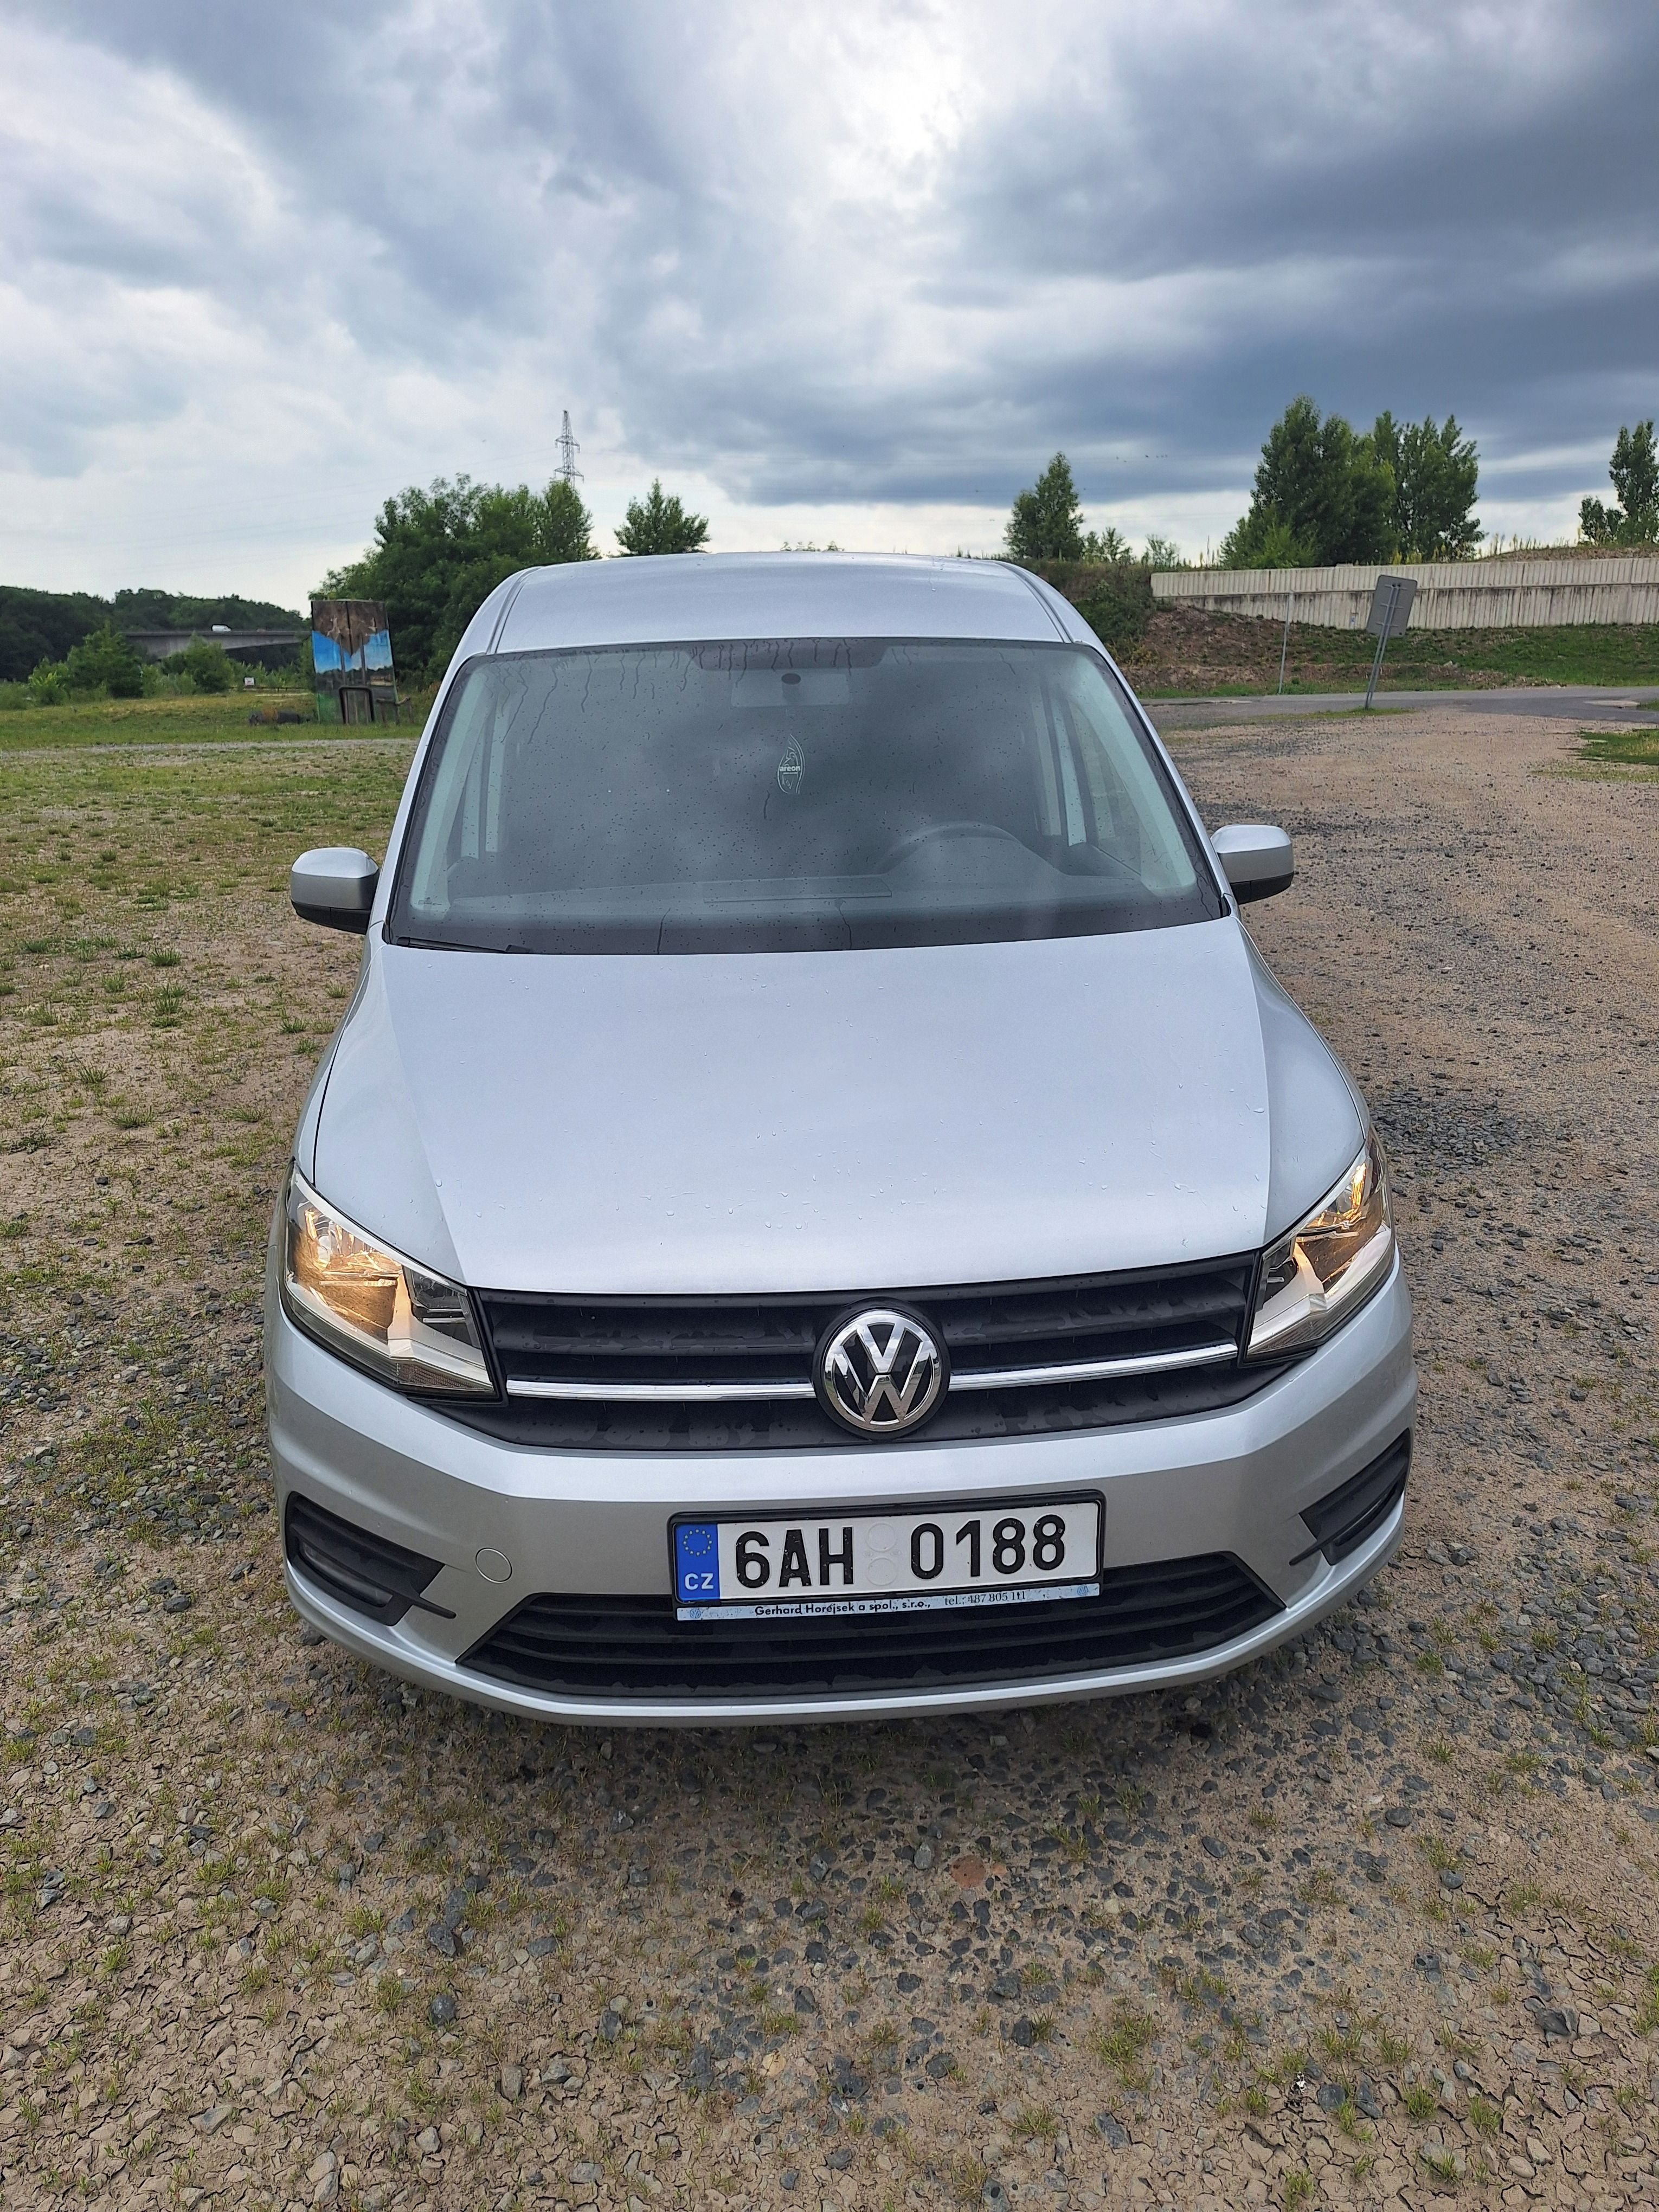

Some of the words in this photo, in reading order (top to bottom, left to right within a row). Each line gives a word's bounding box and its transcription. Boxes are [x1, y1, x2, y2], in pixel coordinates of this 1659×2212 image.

[827, 1313, 937, 1429] VW
[736, 1526, 854, 1589] 6AH
[911, 1514, 1066, 1580] 0188
[685, 1573, 714, 1590] CZ
[755, 1604, 802, 1616] Gerhard
[988, 1592, 1008, 1602] 805
